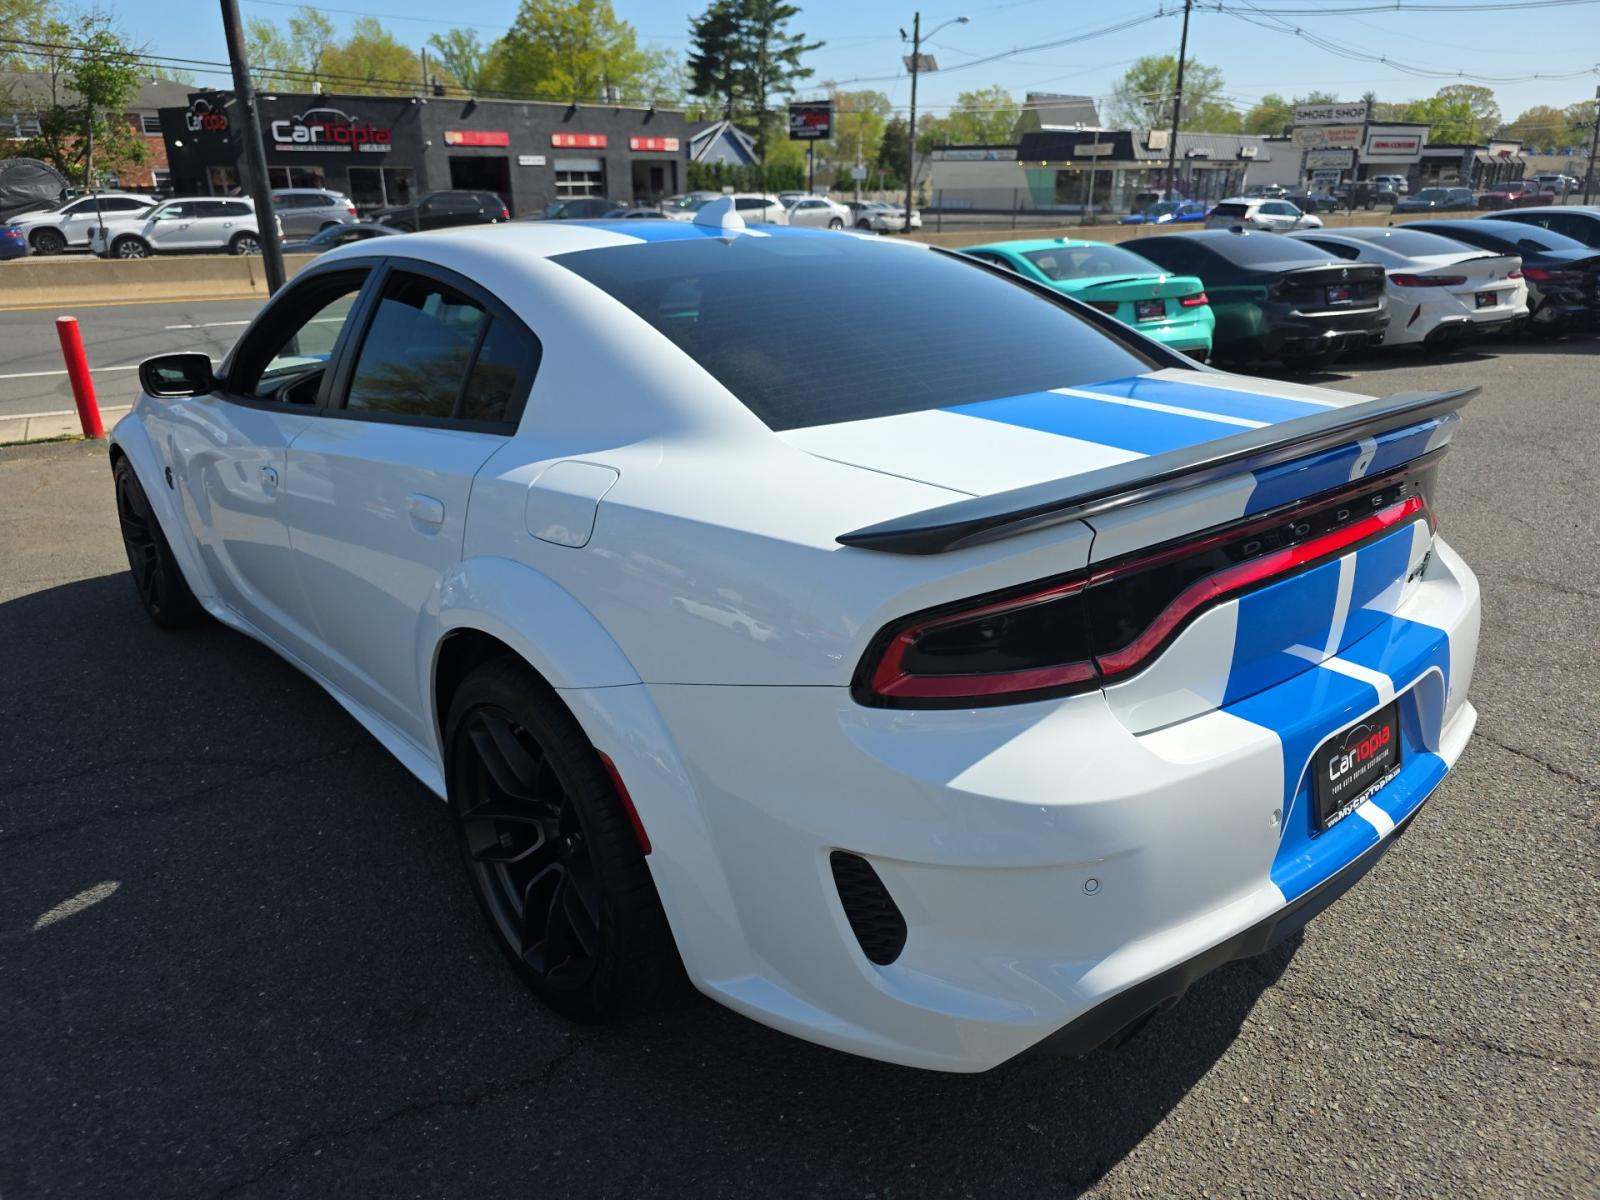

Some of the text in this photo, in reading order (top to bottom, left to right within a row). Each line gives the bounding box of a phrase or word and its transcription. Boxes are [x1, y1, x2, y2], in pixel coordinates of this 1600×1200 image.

[1296, 107, 1366, 121] SMOKE SHOP
[1242, 483, 1408, 556] DODGE
